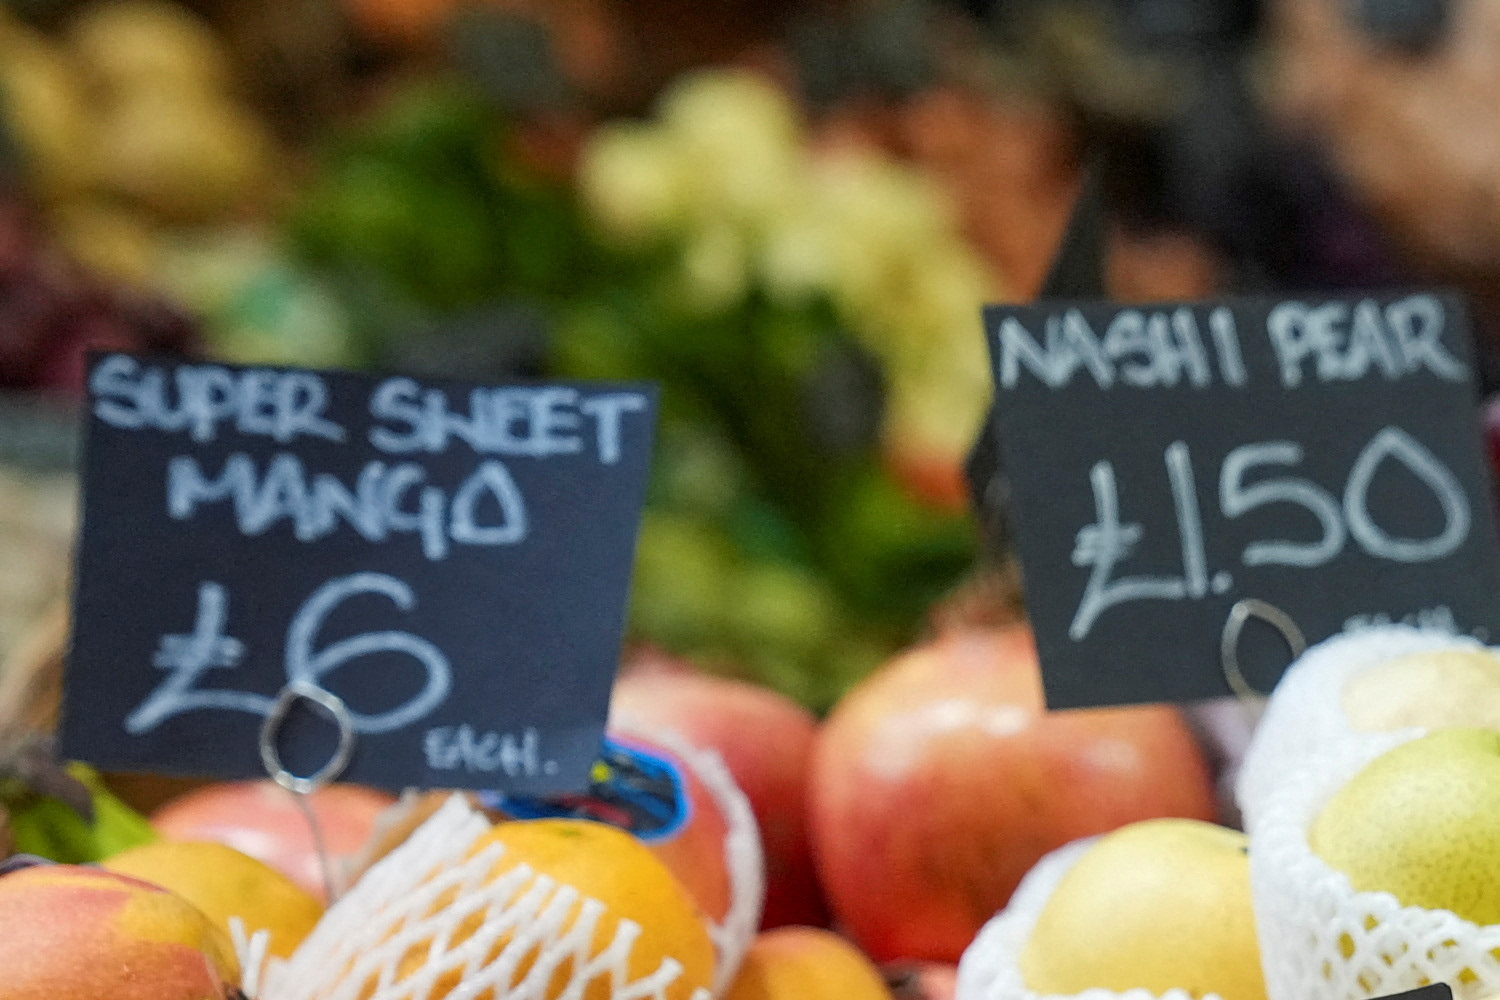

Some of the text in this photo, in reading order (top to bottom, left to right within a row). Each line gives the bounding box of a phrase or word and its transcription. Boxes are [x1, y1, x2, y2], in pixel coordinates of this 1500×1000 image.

[999, 294, 1472, 388] NASHI PEAR
[90, 354, 647, 463] SUPER SWEET
[167, 453, 528, 560] MANGO
[1069, 426, 1473, 642] £1.50
[125, 571, 452, 734] £6
